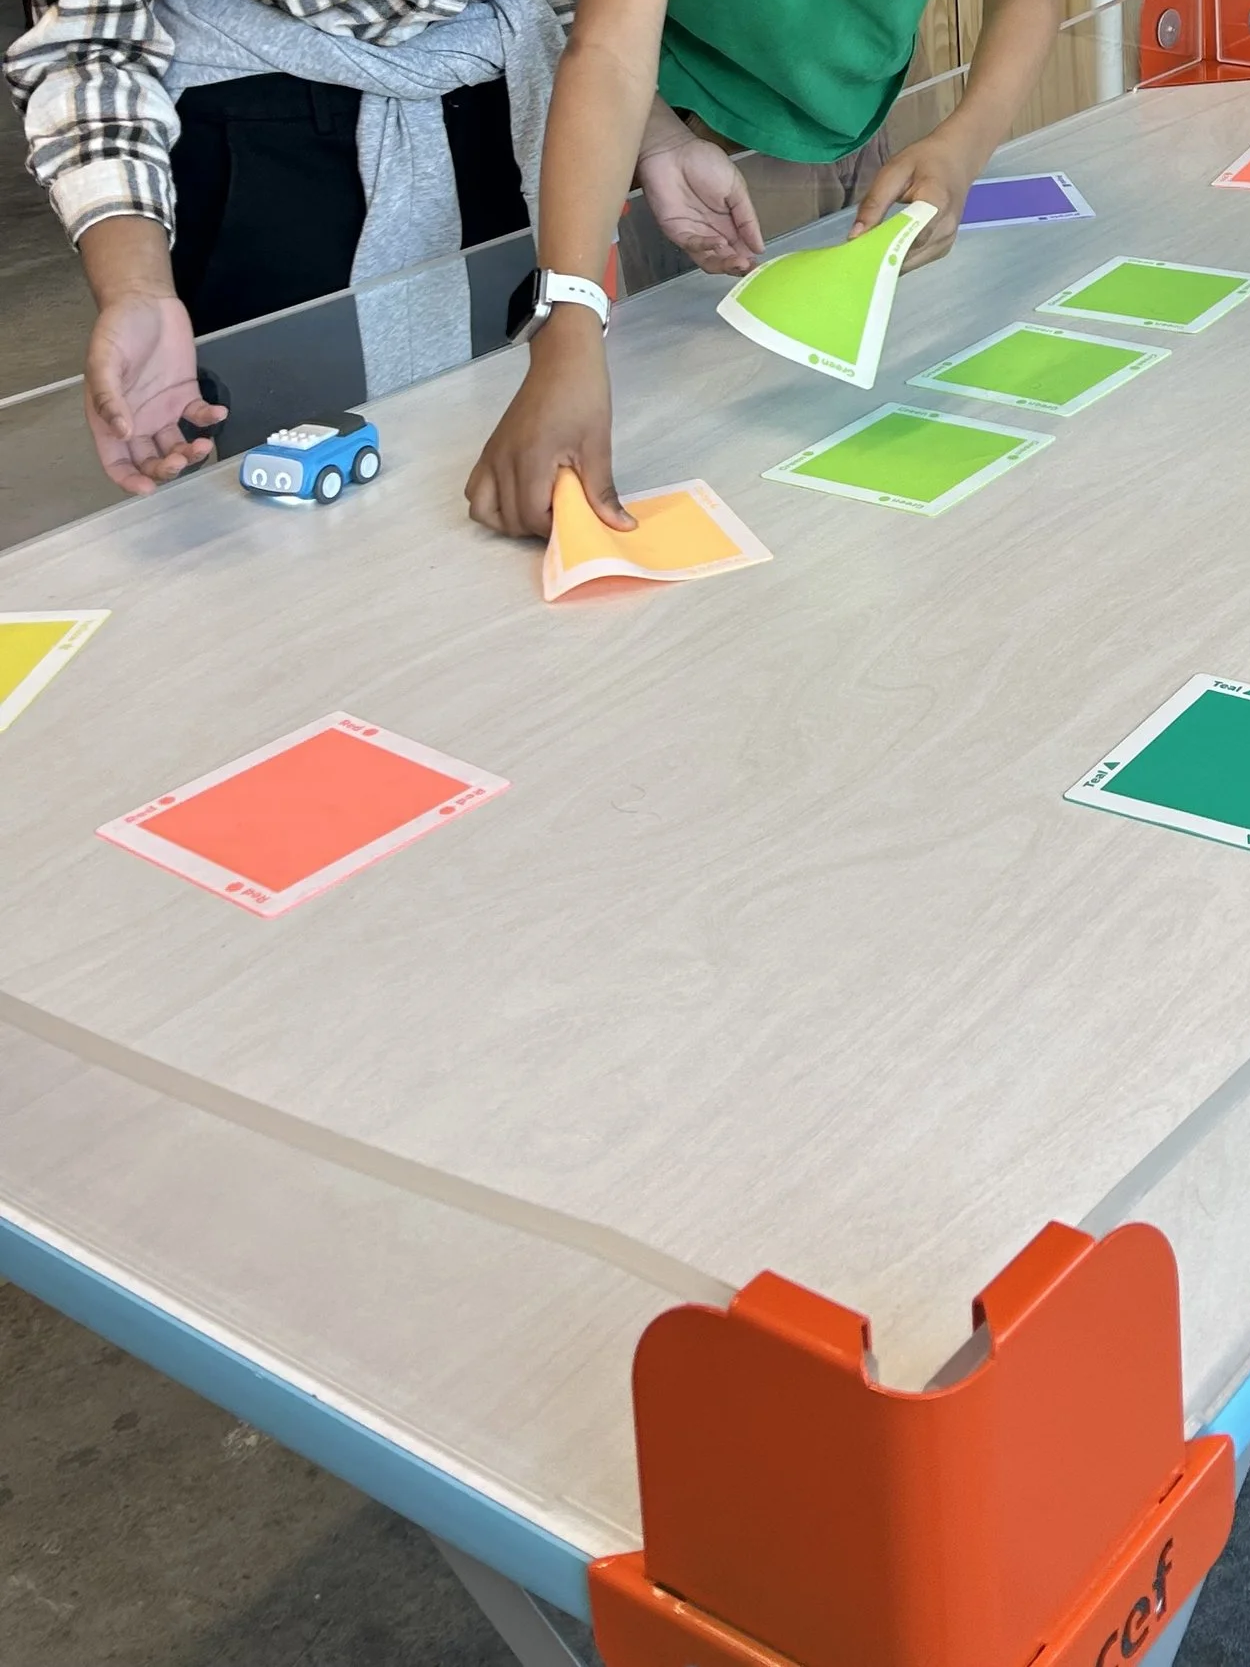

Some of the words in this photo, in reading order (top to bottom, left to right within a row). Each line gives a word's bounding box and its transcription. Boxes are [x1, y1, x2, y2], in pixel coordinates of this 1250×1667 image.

[821, 357, 856, 378] Green
[891, 497, 925, 509] Green
[1213, 680, 1242, 693] Teal
[339, 719, 363, 732] Red
[1083, 769, 1107, 788] Teal
[456, 787, 486, 806] Red
[124, 805, 156, 824] Red
[242, 886, 270, 904] Red
